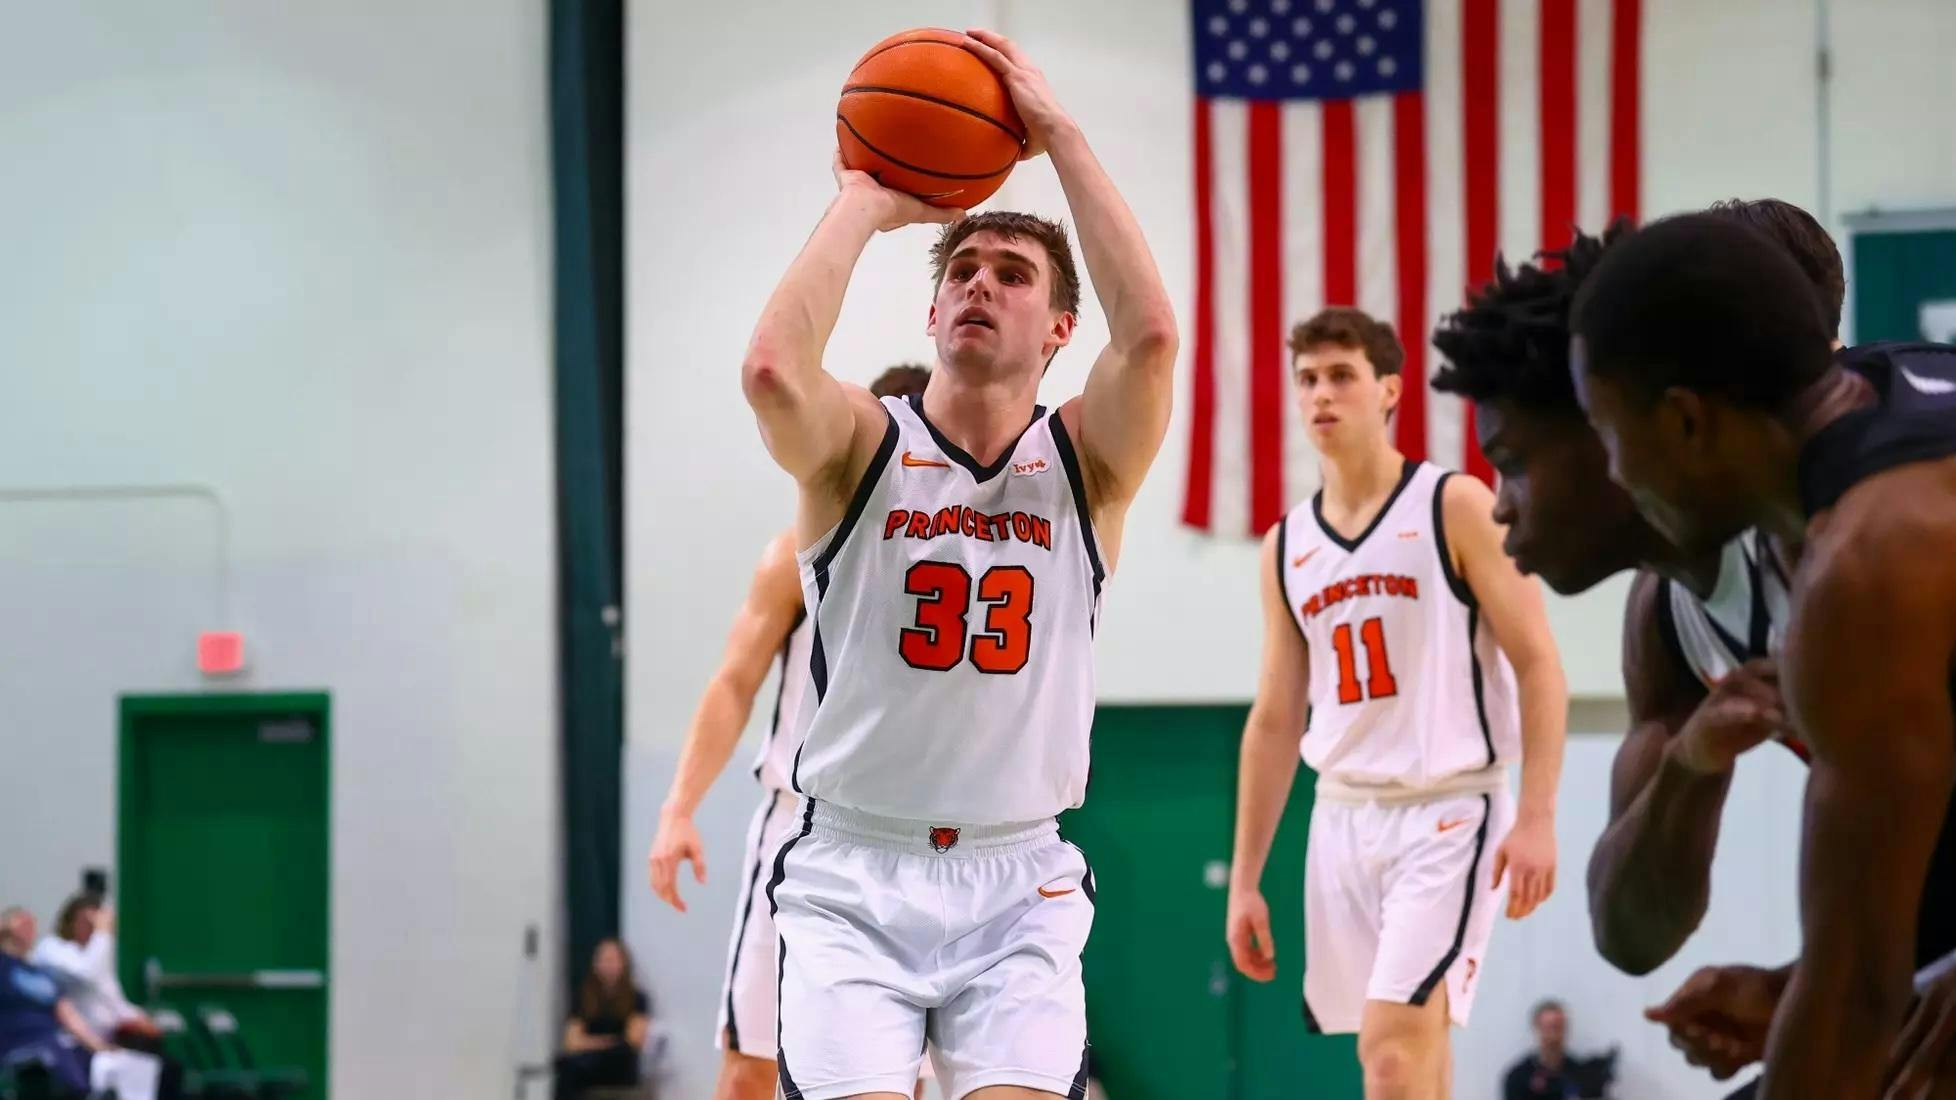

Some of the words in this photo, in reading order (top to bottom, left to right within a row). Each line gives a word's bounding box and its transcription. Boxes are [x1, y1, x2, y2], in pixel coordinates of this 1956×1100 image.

[1013, 462, 1034, 473] Ivy
[883, 504, 1051, 551] PRINCETON
[899, 560, 1035, 675] 33
[1332, 617, 1398, 706] 11
